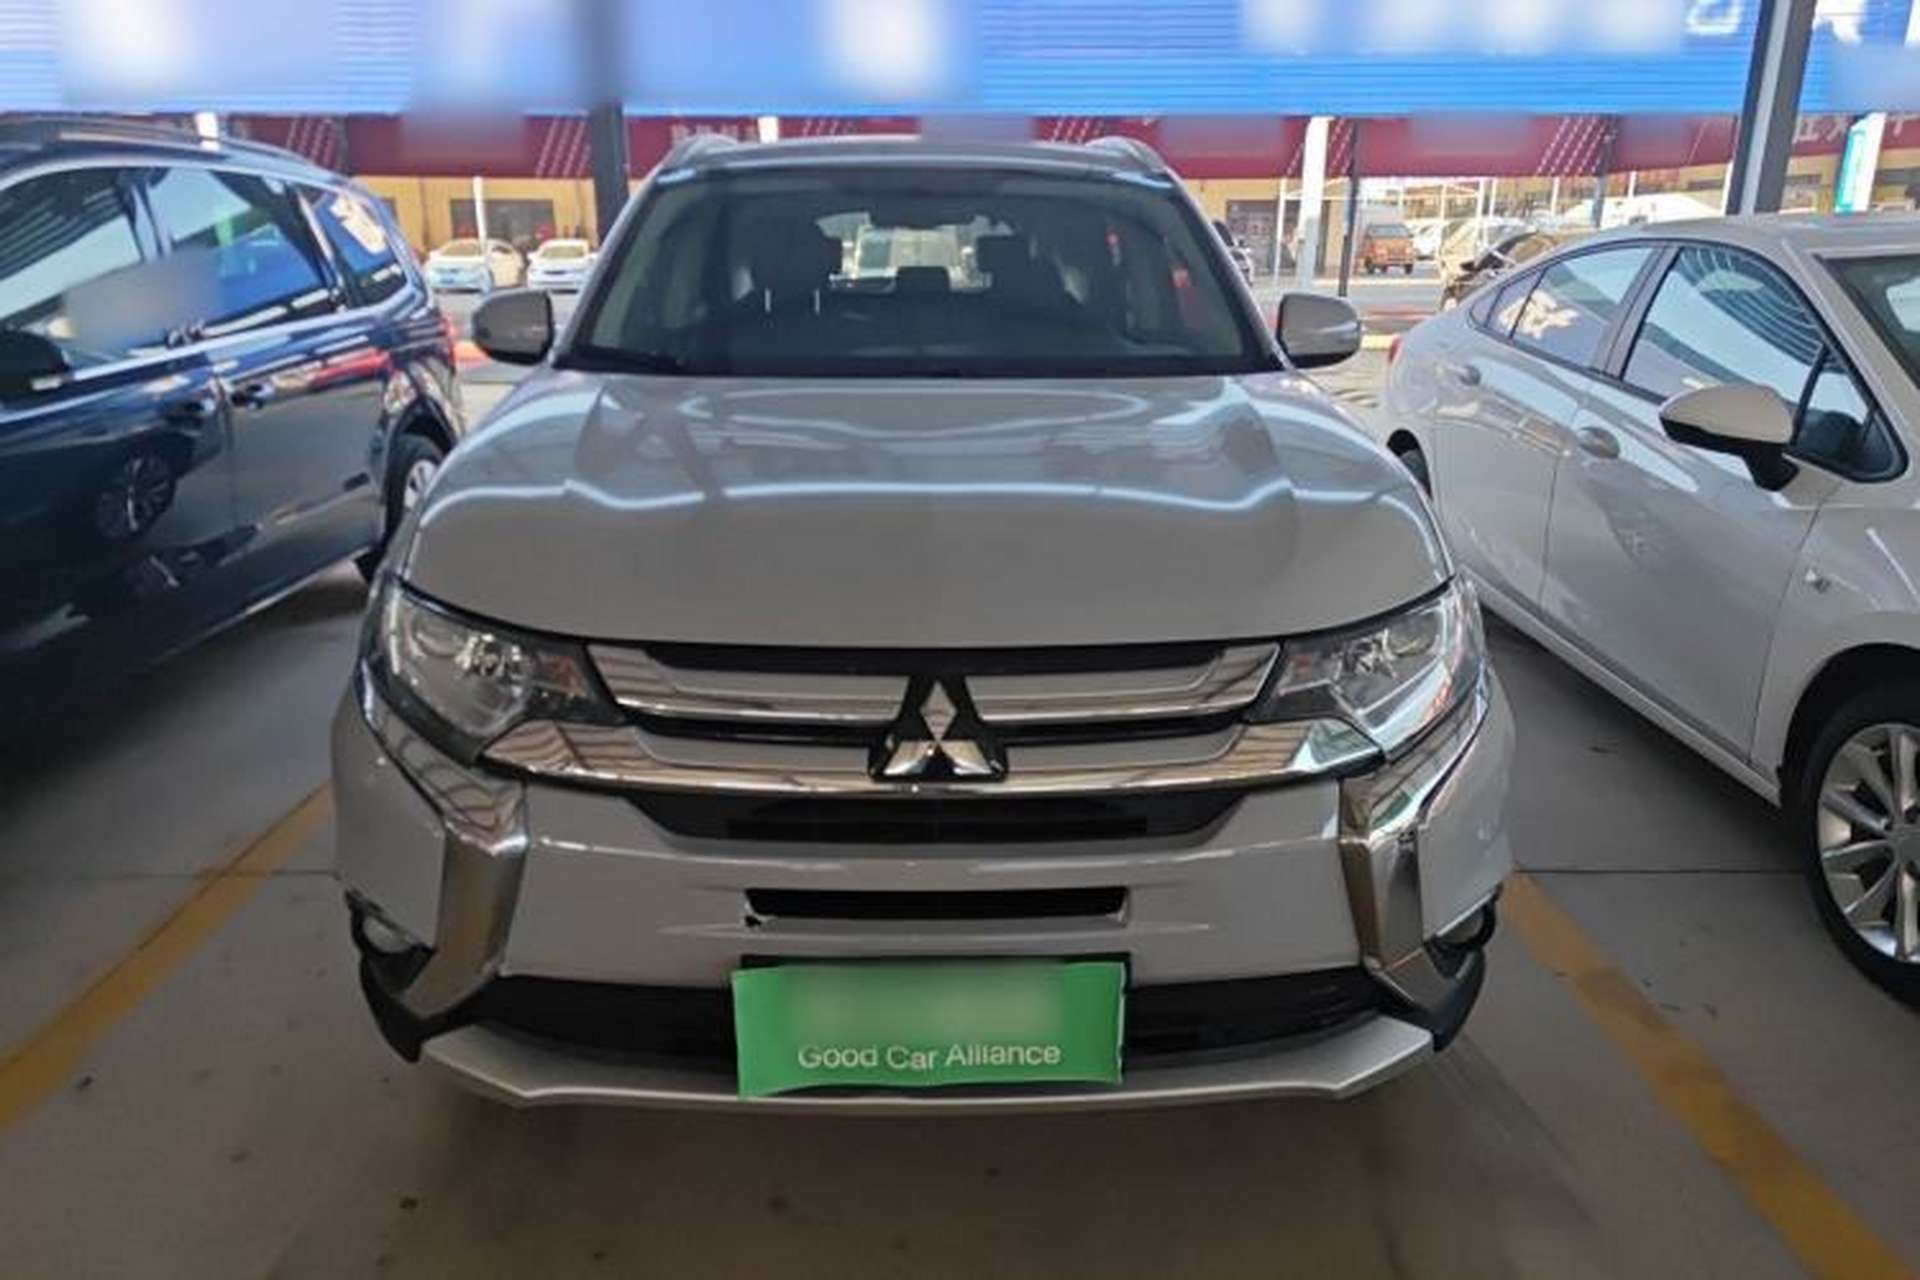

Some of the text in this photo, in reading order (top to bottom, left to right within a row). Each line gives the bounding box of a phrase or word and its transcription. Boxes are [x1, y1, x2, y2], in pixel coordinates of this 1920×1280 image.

[797, 1043, 1061, 1070] Good Car Alliance
